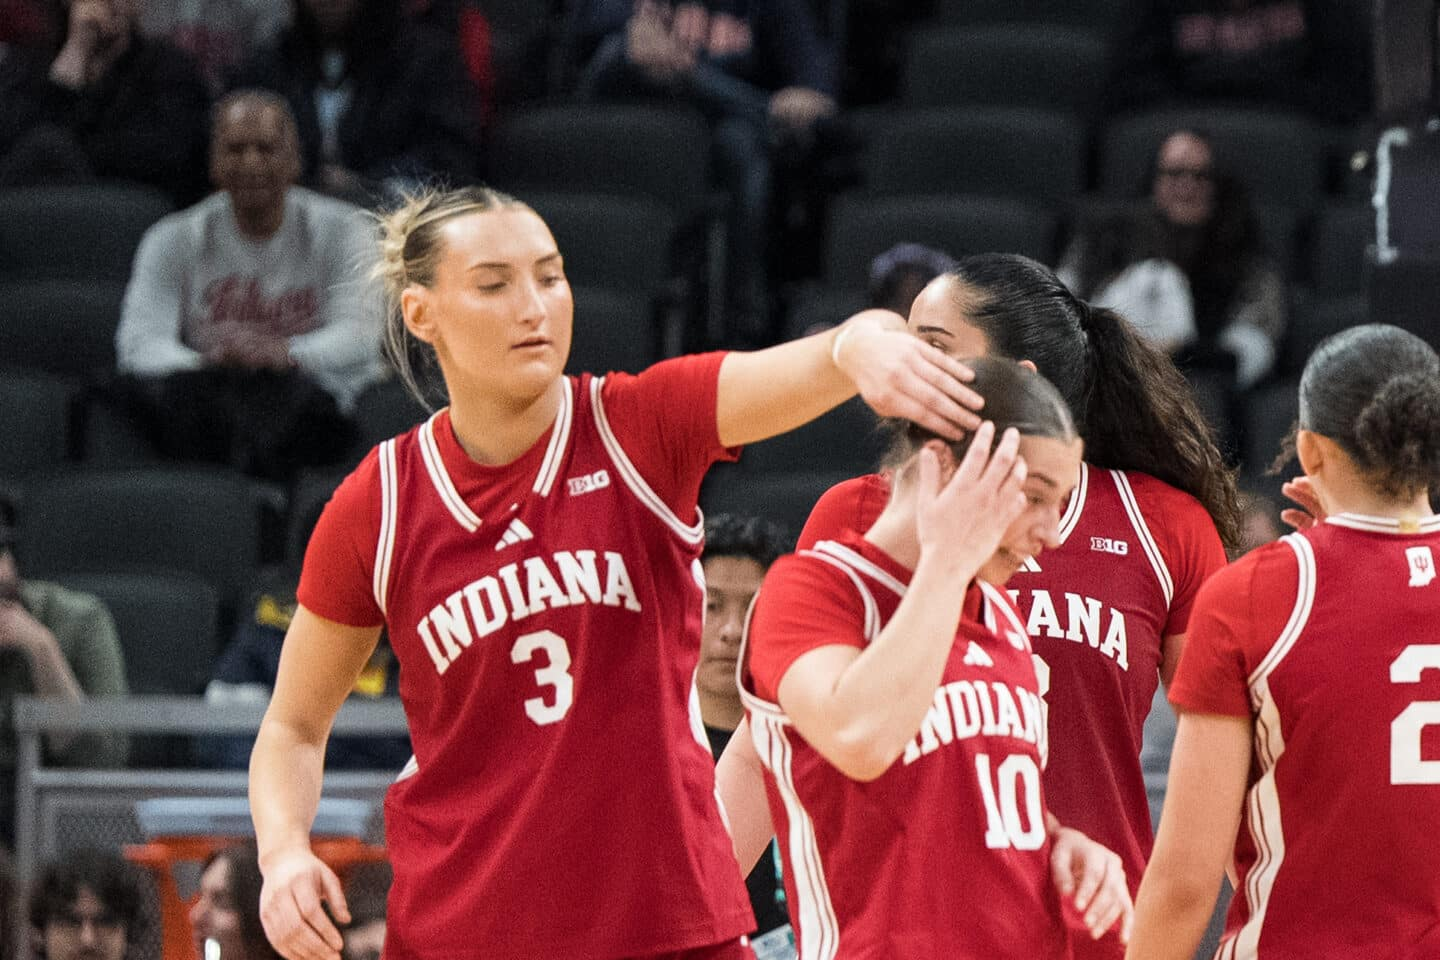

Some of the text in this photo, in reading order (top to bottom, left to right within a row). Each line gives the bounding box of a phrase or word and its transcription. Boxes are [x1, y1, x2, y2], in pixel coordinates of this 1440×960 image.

[417, 549, 642, 675] INDIANA
[510, 629, 573, 726] 3
[975, 752, 1047, 850] 10
